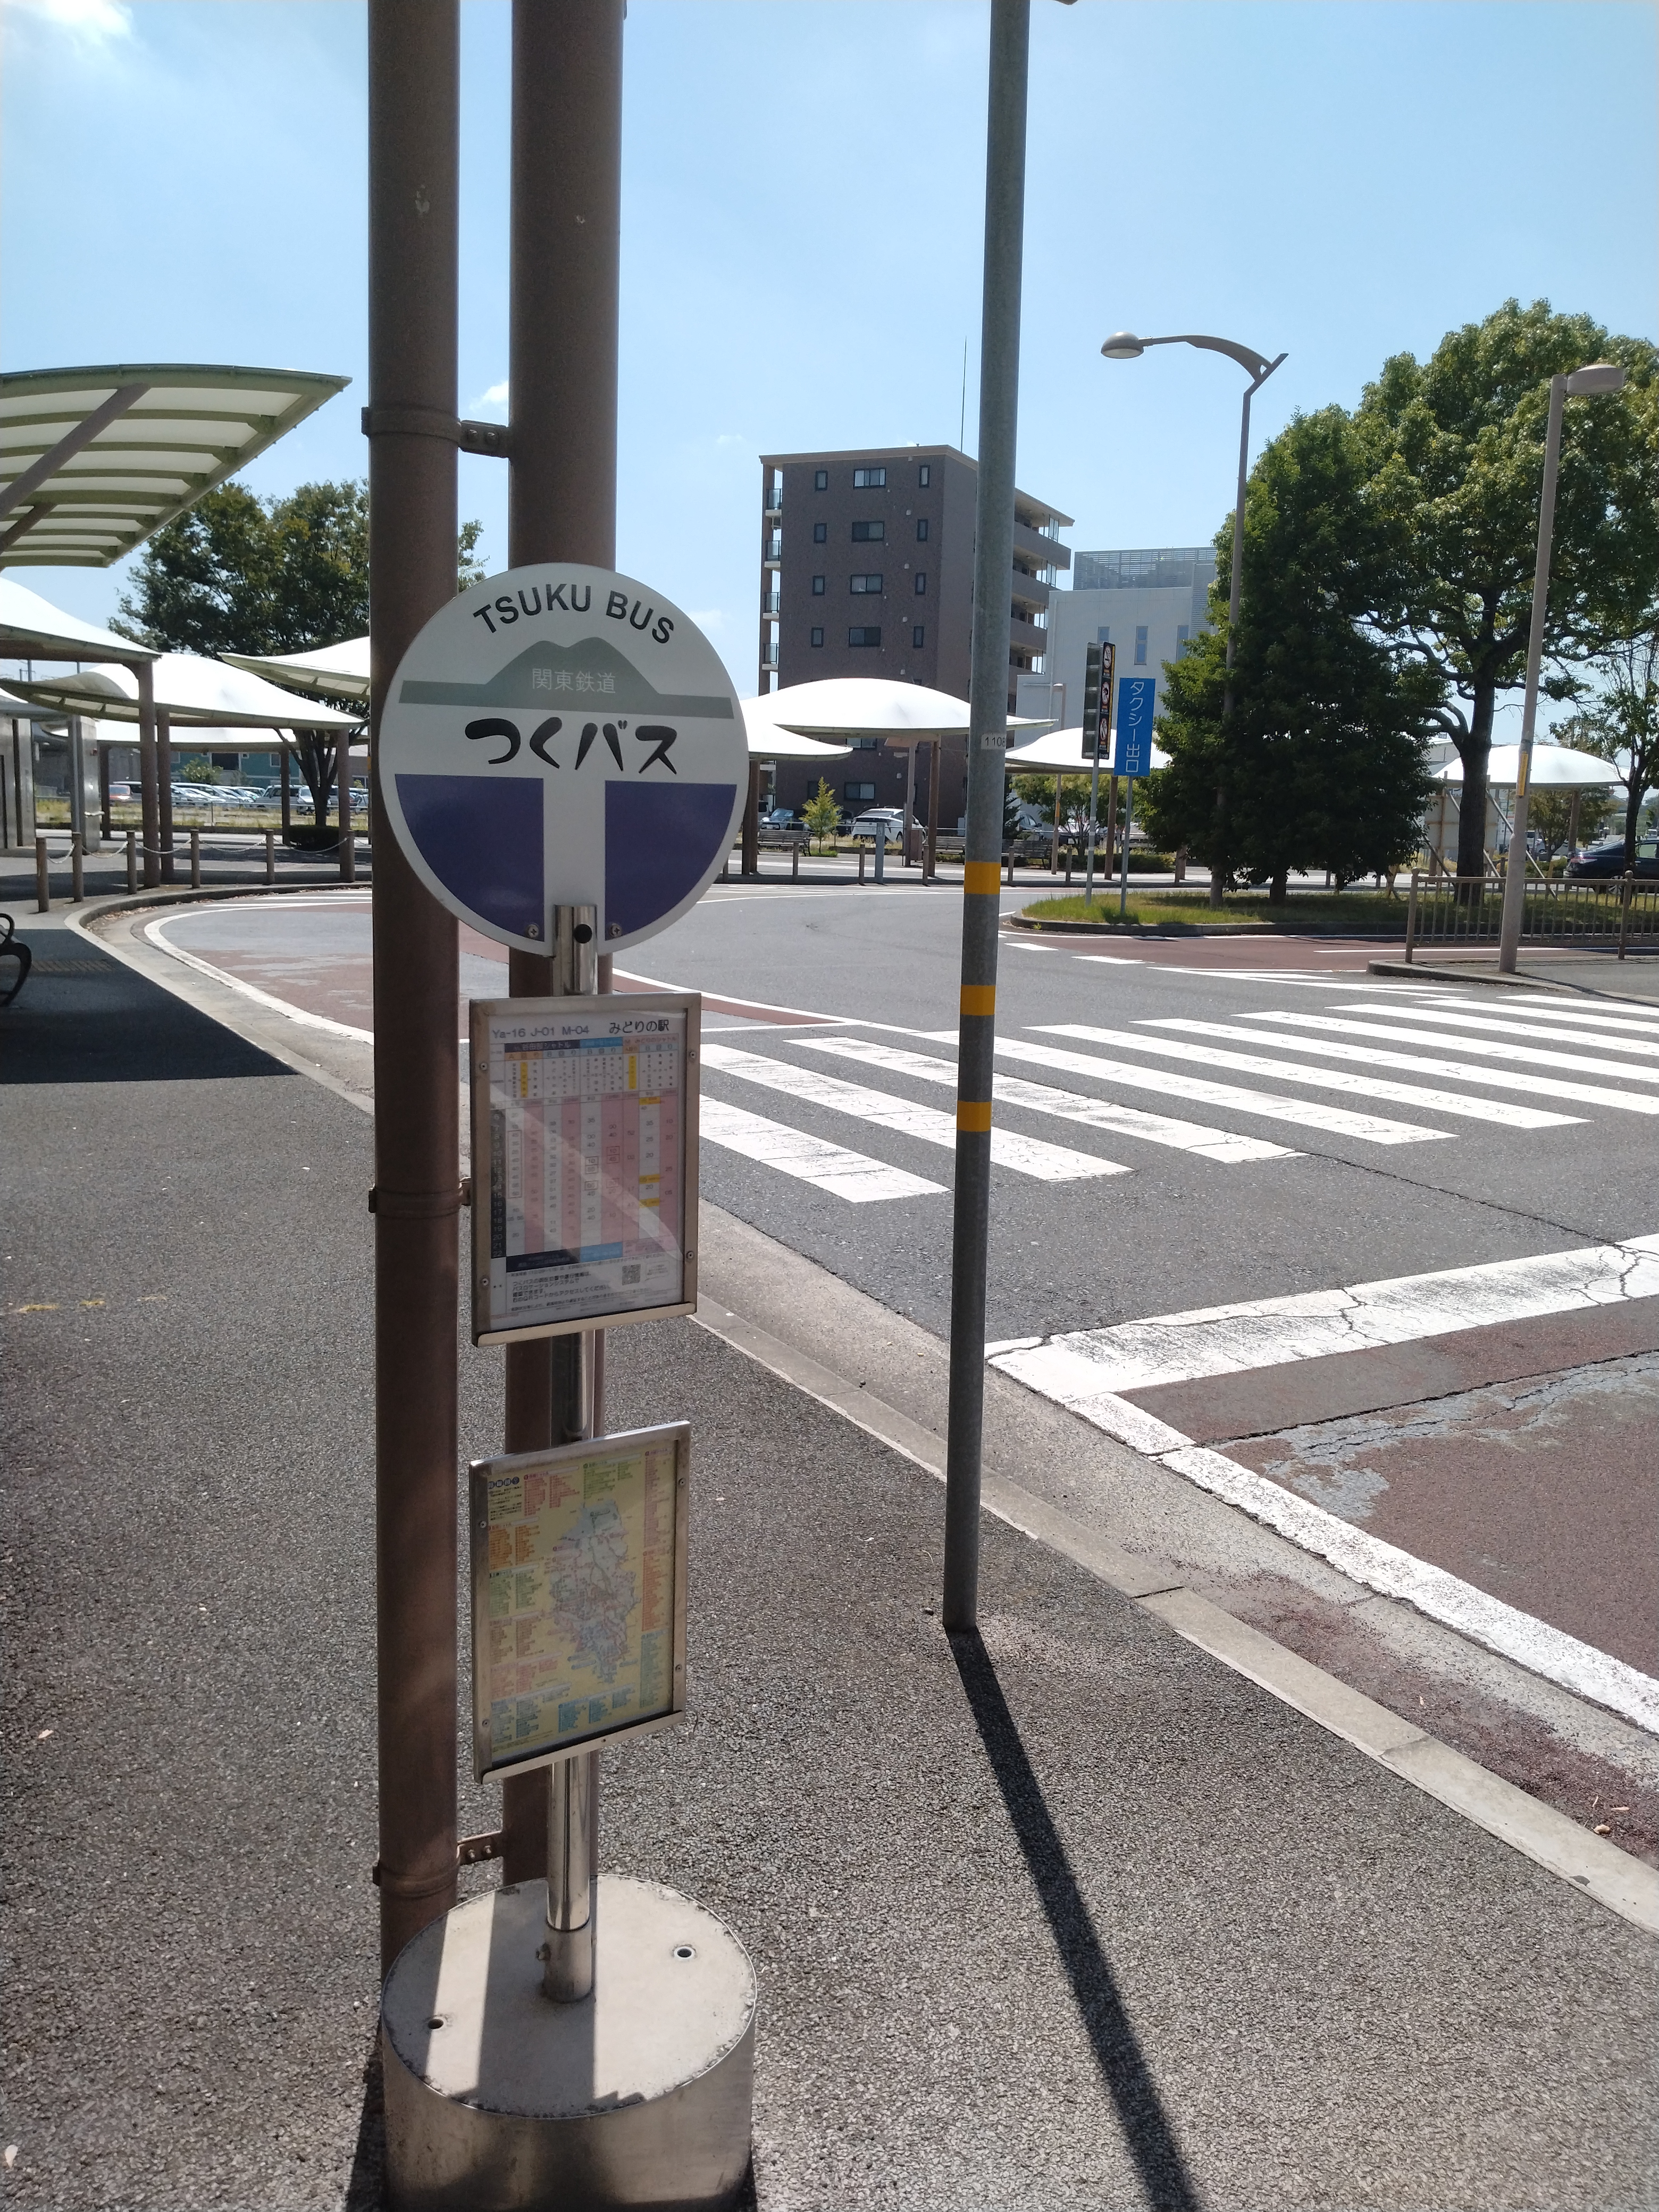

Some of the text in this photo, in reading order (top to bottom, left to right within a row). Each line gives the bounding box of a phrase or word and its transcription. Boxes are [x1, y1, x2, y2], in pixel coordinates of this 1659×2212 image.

[473, 584, 674, 644] TSUKU BUS
[532, 668, 616, 693] 関東鉄道
[465, 717, 677, 775] つくバス
[1126, 682, 1144, 773] タクシー出口
[492, 1019, 669, 1038] Ya-16 J-01 M-04 みどりの駅
